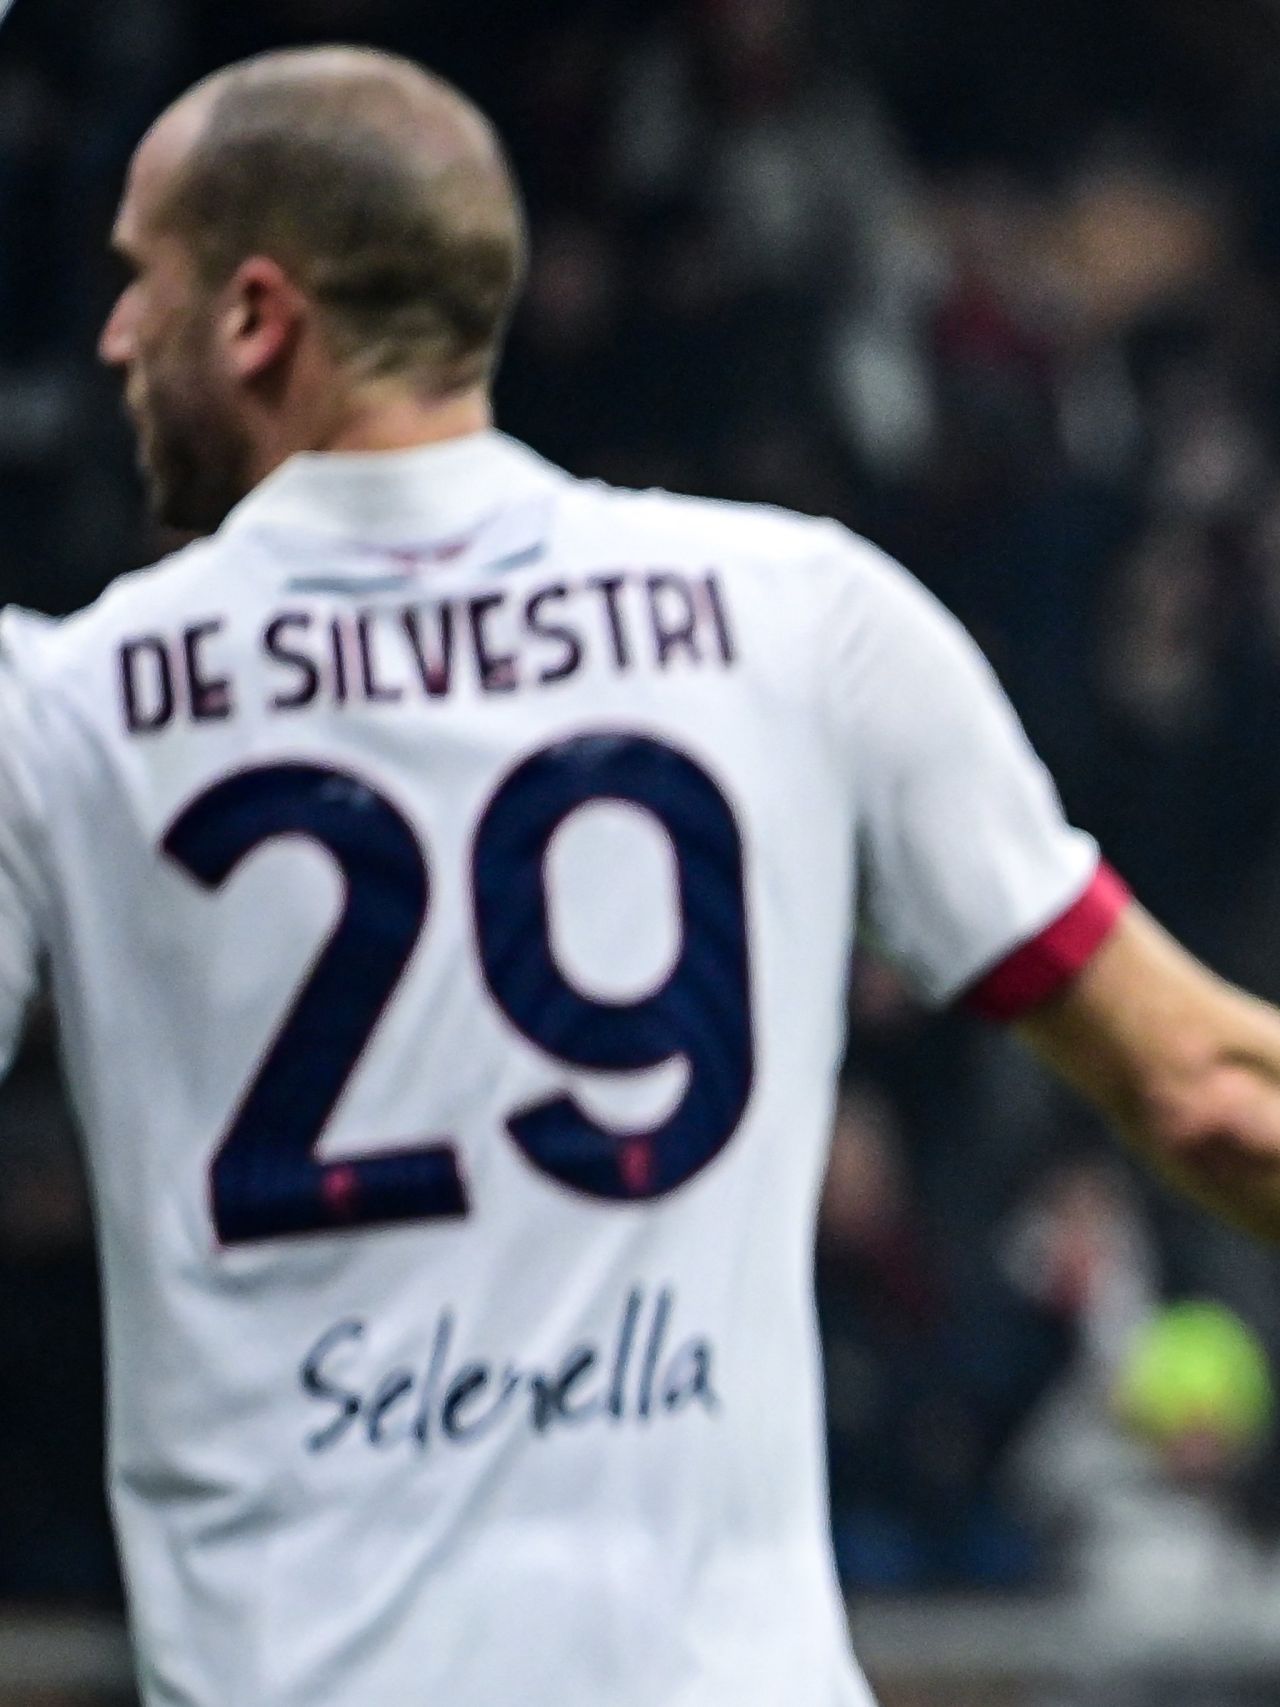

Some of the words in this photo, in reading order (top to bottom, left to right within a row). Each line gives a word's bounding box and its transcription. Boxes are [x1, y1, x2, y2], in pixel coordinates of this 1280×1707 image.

[118, 618, 233, 737] DE
[260, 569, 736, 710] SILVESTRI
[160, 730, 756, 1248] 29
[302, 1287, 719, 1452] Selenella
